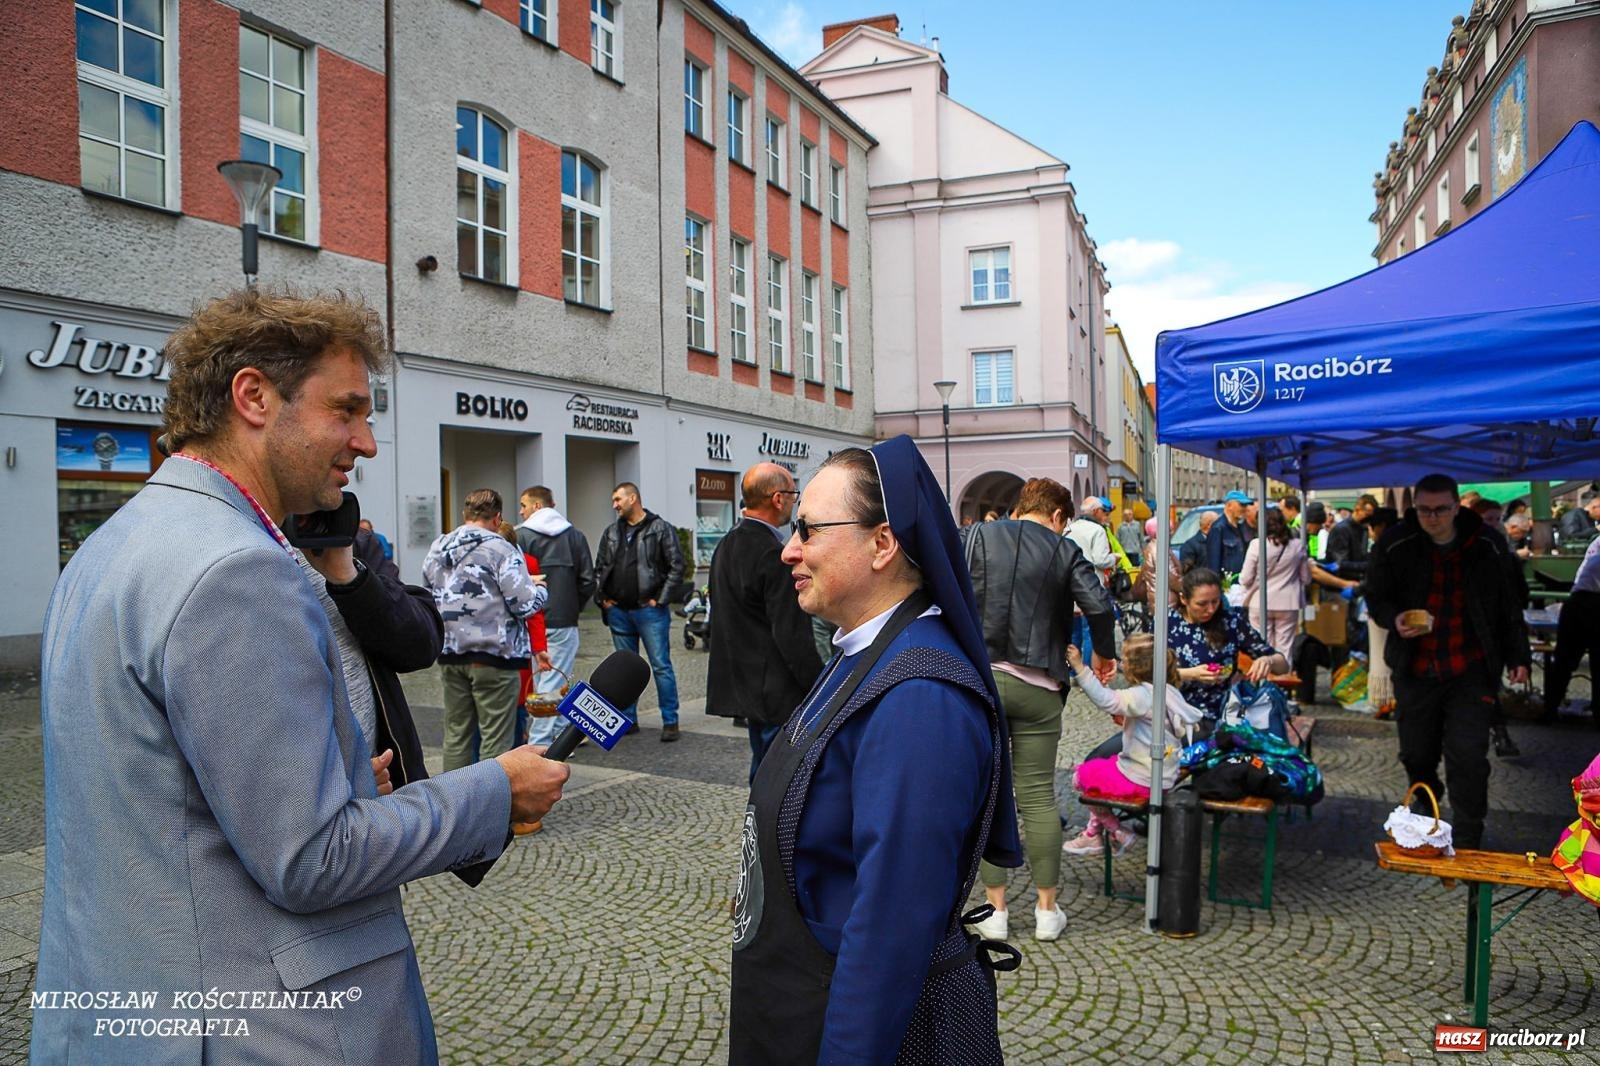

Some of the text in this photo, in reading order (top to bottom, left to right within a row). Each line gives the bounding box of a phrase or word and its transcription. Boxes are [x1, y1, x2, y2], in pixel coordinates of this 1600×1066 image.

[28, 320, 171, 381] JUBI
[1274, 355, 1393, 382] Racibórz
[77, 386, 165, 413] ZEGAR
[456, 392, 529, 421] BOLKO
[1274, 387, 1305, 402] 1217
[590, 403, 639, 419] RESTAURACJA
[573, 414, 633, 435] RACIBORSKA
[759, 432, 811, 458] JUBILER
[700, 476, 726, 491] ZŁOTO
[568, 709, 607, 743] KATOWICE
